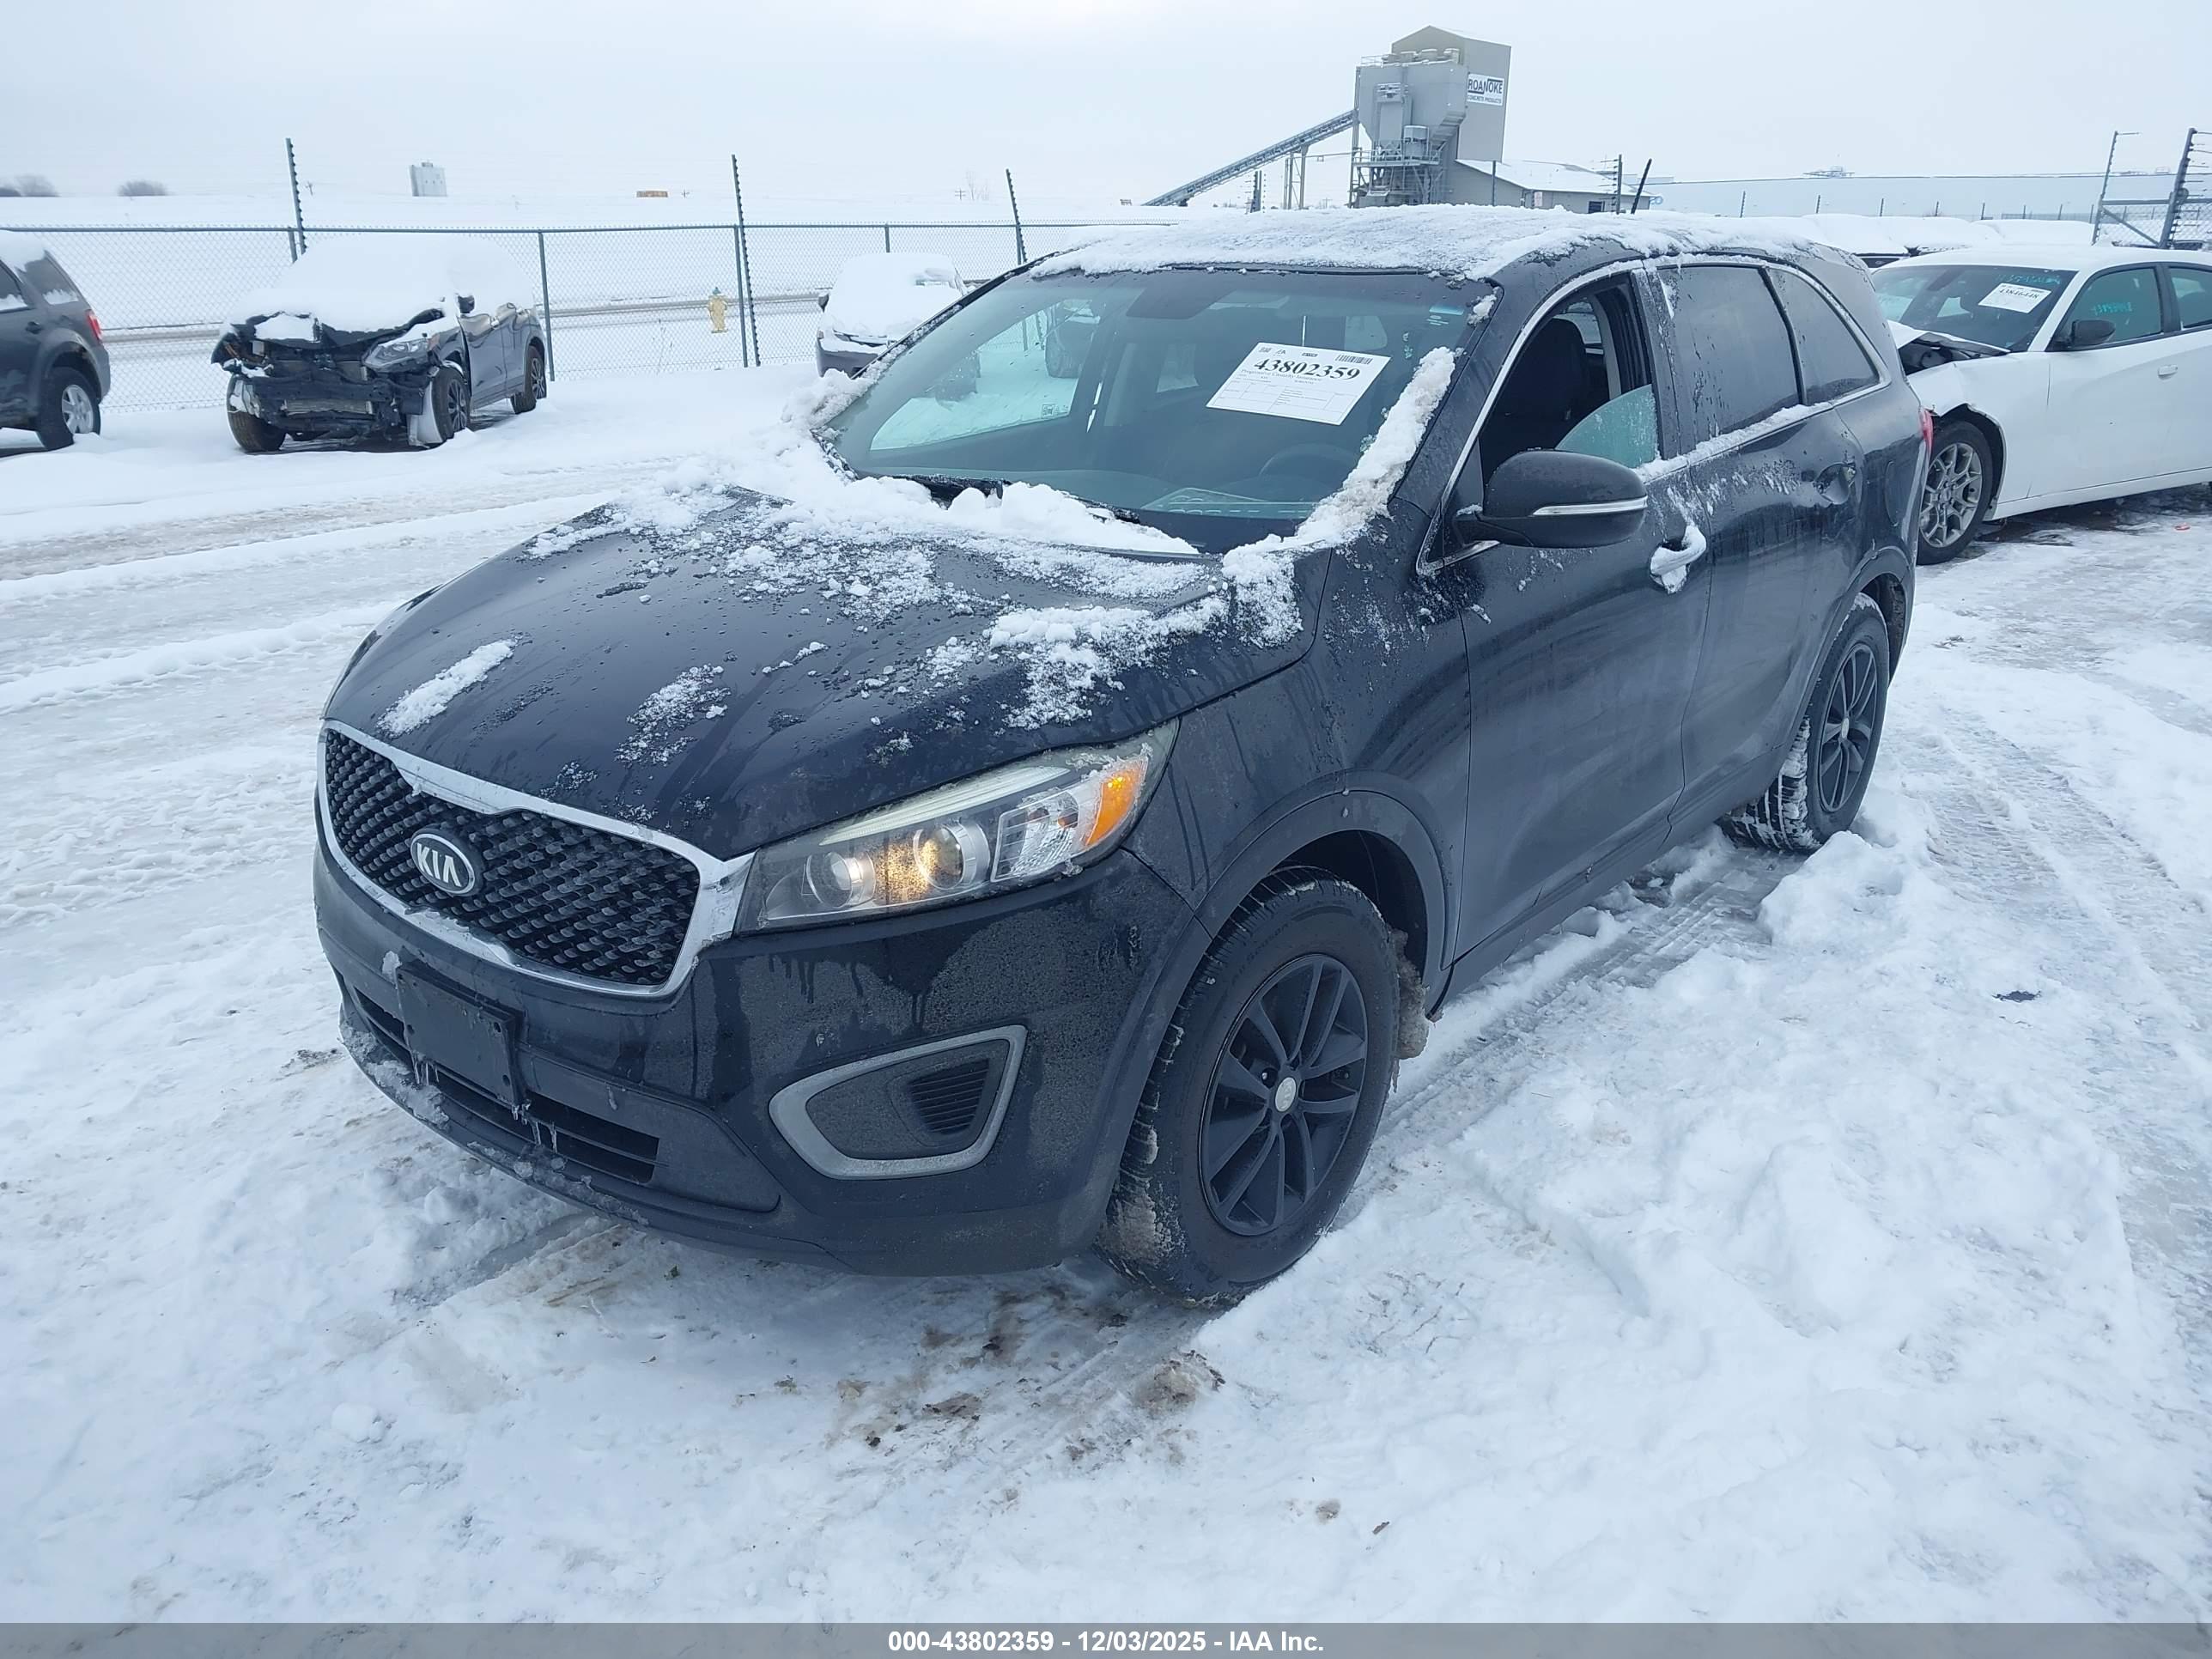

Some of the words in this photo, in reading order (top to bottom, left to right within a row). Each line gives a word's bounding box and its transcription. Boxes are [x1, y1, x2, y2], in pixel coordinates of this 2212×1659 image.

[1468, 78, 1503, 94] ROANOKE
[1254, 358, 1361, 380] 43802359
[416, 842, 462, 888] KIA
